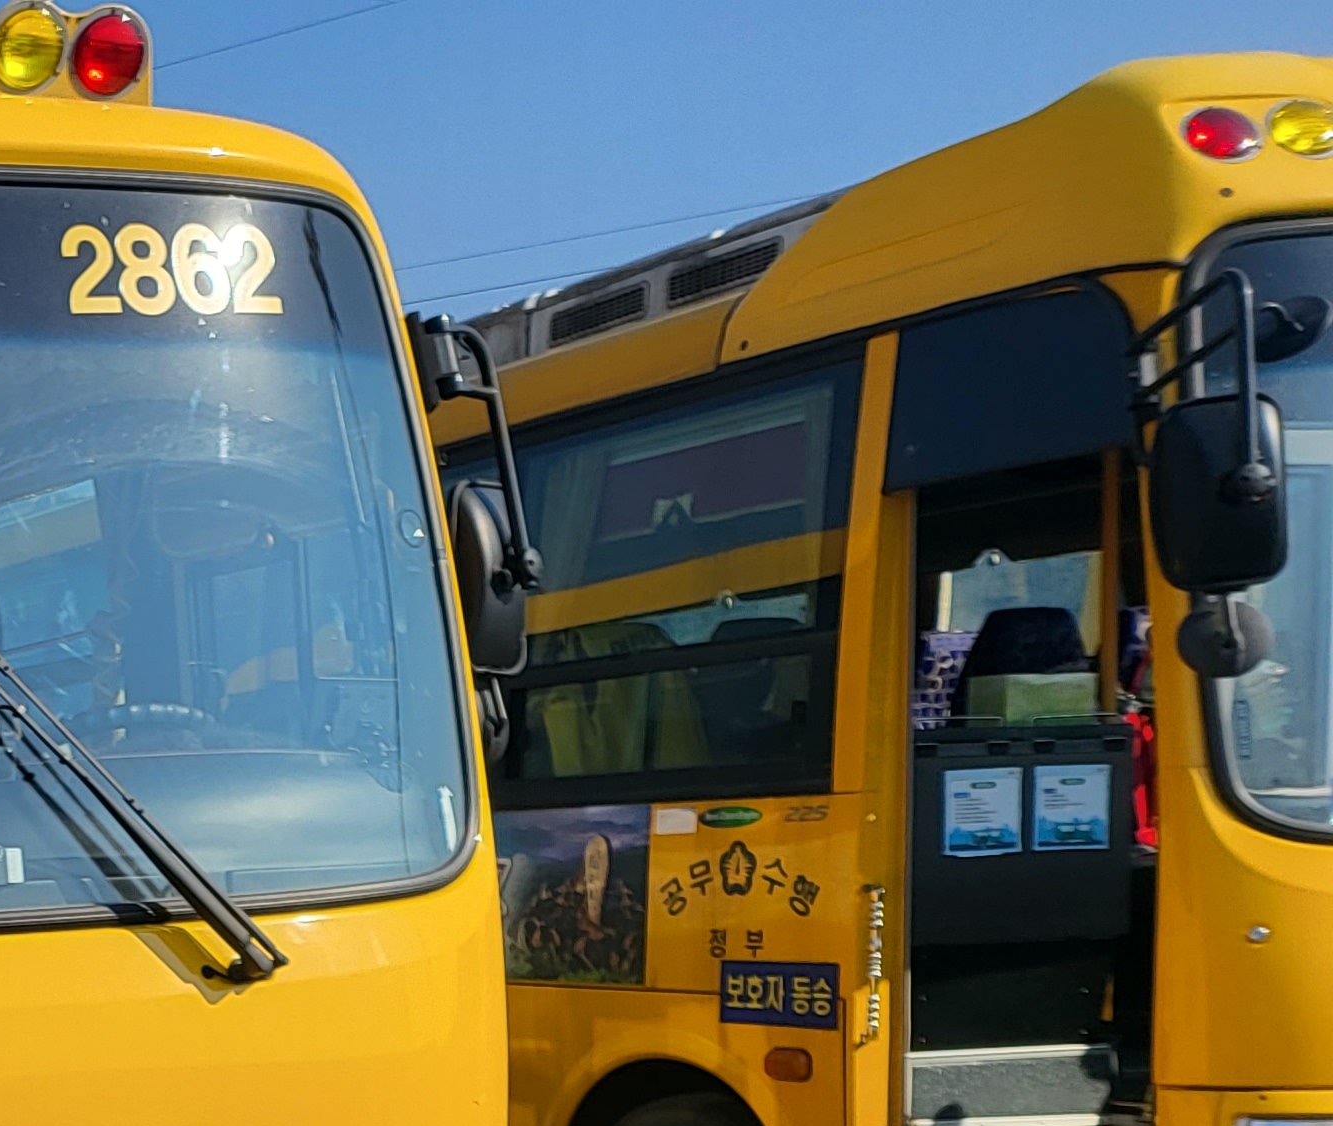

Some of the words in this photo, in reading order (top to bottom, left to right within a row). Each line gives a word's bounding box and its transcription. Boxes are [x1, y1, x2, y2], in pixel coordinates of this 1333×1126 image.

[60, 222, 284, 316] 2862
[725, 973, 785, 1013] 보호자
[790, 976, 833, 1017] 동승
